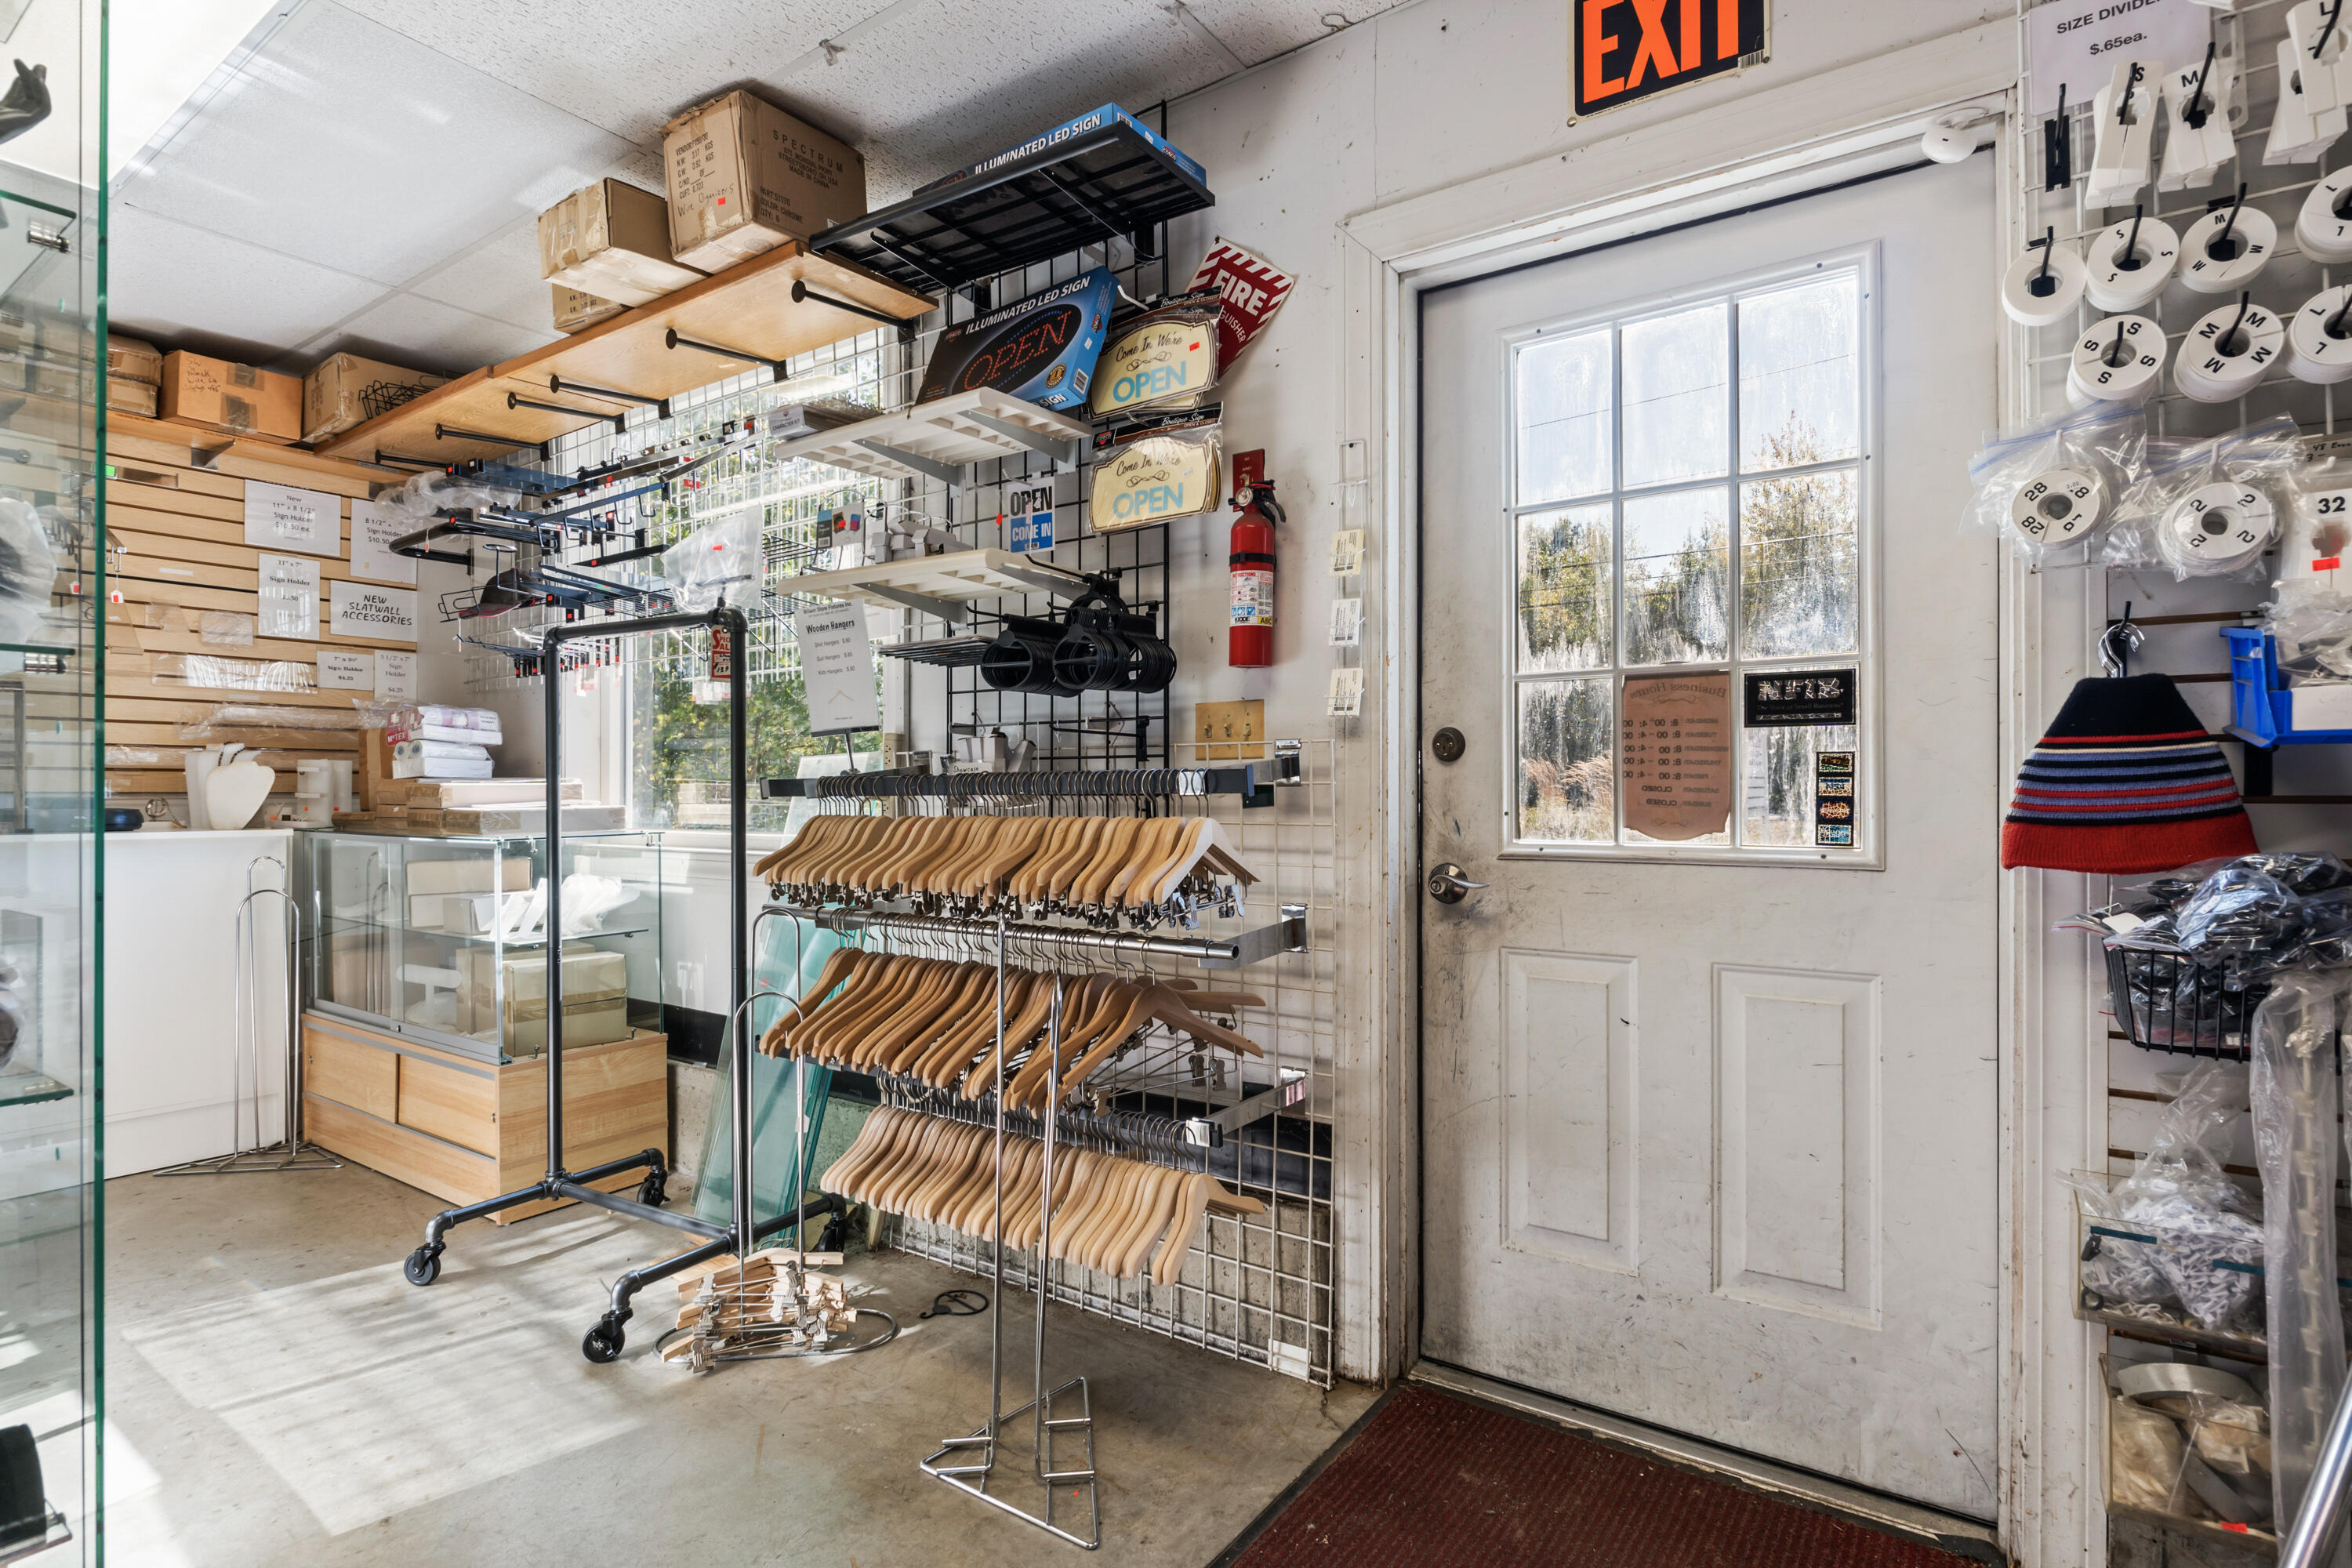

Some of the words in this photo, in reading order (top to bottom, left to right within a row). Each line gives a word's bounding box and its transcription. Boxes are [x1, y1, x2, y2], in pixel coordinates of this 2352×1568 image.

[2056, 13, 2094, 34] SIZE
[1583, 0, 1739, 104] EXIT
[2090, 32, 2147, 55] $.65ea.
[2181, 70, 2199, 88] M
[773, 129, 844, 173] SPECTRUM
[975, 140, 1047, 175] ILLUMINATED
[1048, 128, 1070, 147] LED
[1072, 113, 1102, 136] SIGN
[789, 165, 804, 177] MADE
[813, 176, 830, 190] CHINA
[828, 176, 839, 187] USA
[780, 207, 804, 224] CHROME
[2215, 214, 2226, 225] M
[2116, 229, 2124, 239] S
[2107, 273, 2118, 282] S
[1160, 296, 1187, 308] Boutique
[1189, 291, 1205, 300] Sign
[1212, 269, 1269, 317] FIRE
[965, 300, 1037, 335] ILLUMINATED
[1037, 289, 1060, 307] LED
[1061, 276, 1091, 298] SIGN
[2127, 321, 2143, 336] S
[2245, 312, 2267, 328] M
[2198, 322, 2220, 339] M
[964, 310, 1073, 390] OPEN
[1116, 343, 1139, 363] Come
[1157, 331, 1182, 347] We're
[2084, 339, 2100, 352] S
[2140, 354, 2157, 368] S
[1112, 360, 1186, 403] OPEN
[2098, 371, 2112, 384] S
[1040, 394, 1067, 407] SIGN
[1161, 417, 1188, 427] Boutique
[1189, 410, 1204, 423] Sign
[1116, 460, 1138, 477] Come
[2024, 481, 2048, 502] 28
[1010, 485, 1052, 517] OPEN
[1112, 482, 1184, 519] OPEN
[2318, 495, 2346, 514] 32
[274, 511, 289, 521] Sign
[367, 527, 381, 536] Sign
[381, 528, 403, 539] Holder
[1012, 524, 1039, 542] COME
[1041, 522, 1051, 538] IN
[2021, 515, 2045, 535] 28
[368, 535, 390, 545] $10.50
[269, 575, 286, 585] Sign
[287, 577, 311, 586] Holder
[363, 594, 387, 604] NEW
[349, 601, 401, 615] SLATWALL
[342, 611, 413, 626] ACCESSORIES
[806, 623, 829, 634] Wooden
[829, 619, 855, 630] Hangers
[1260, 616, 1272, 625] ABC
[953, 765, 979, 774] Showcase
